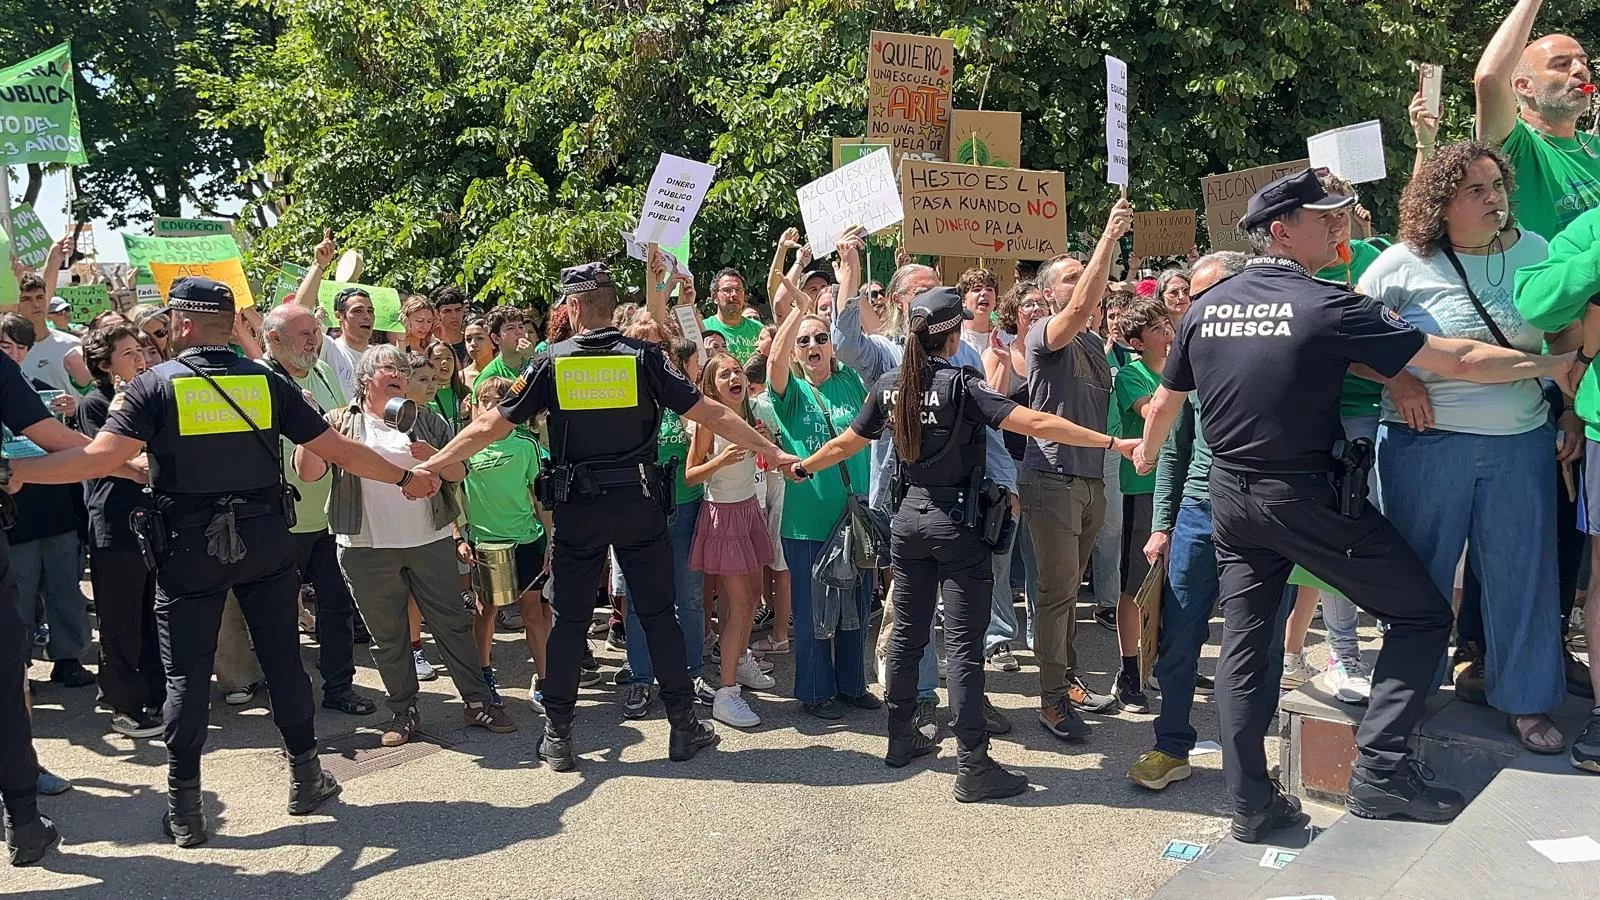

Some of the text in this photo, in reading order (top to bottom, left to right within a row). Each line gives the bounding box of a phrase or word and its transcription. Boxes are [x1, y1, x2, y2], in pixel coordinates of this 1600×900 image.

[882, 42, 942, 71] QUIERO
[892, 70, 944, 87] ESCUELA
[873, 83, 949, 127] DE ARTE
[24, 116, 59, 132] DEL
[872, 121, 915, 136] NO UNA
[25, 131, 80, 152] AÑOS
[930, 140, 943, 151] DE
[666, 177, 695, 189] DINERO
[910, 167, 1050, 197] HESTO ES L K
[1205, 173, 1258, 203] AZCÓN
[653, 199, 686, 213] PARA LA
[809, 199, 829, 224] LA
[910, 195, 1058, 220] PASA KUANDO NO
[161, 219, 224, 231] EDUCACIÓN
[935, 218, 981, 234] DINERO
[984, 219, 1002, 235] PA
[1005, 219, 1023, 235] LA
[1219, 209, 1241, 227] LA
[123, 237, 160, 251] DON
[1006, 235, 1056, 254] PÚVLIKA
[1203, 303, 1294, 320] POLICIA
[1201, 320, 1292, 338] HUESCA
[563, 368, 629, 384] POLICIA
[568, 387, 626, 401] HUESCA
